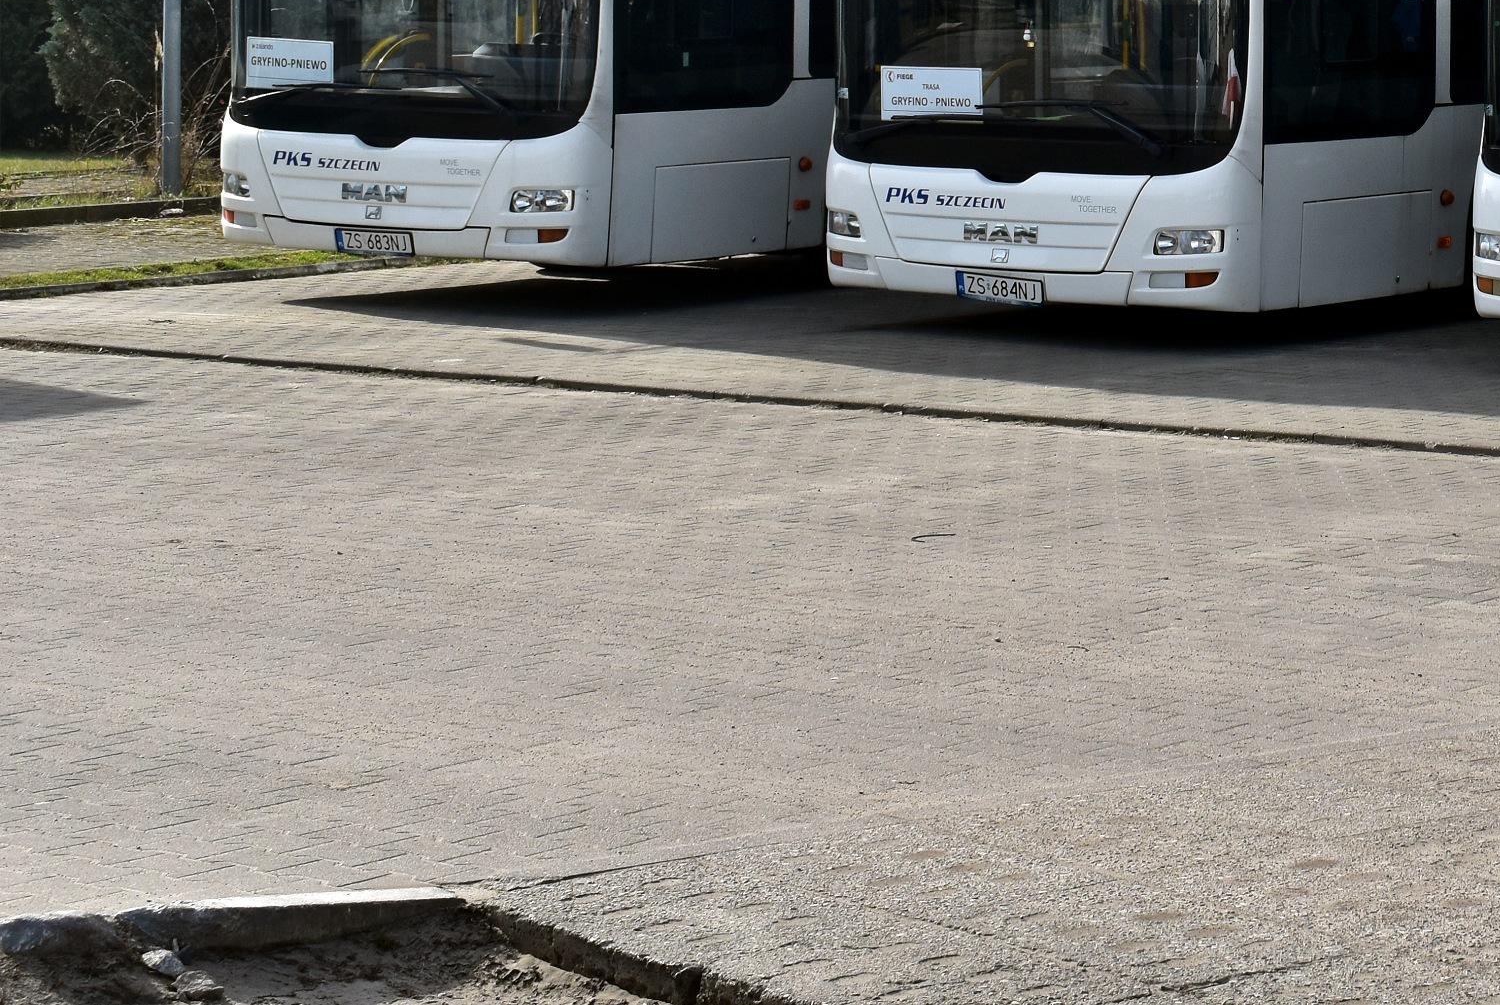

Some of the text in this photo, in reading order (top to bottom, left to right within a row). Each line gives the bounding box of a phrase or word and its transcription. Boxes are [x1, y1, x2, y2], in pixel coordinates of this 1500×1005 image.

[251, 56, 327, 71] GRYFINO-PNIEWO
[922, 83, 940, 91] TRASA
[891, 96, 928, 106] GRYFINO
[936, 97, 971, 107] PNIEWO
[273, 150, 380, 172] PKS SZCZECIN
[341, 182, 408, 203] MAN
[885, 186, 1006, 210] PKS SZCZECIN
[345, 232, 407, 252] ZS 683NJ
[963, 221, 1039, 244] MAN
[966, 275, 1036, 301] ZS 684NJ
